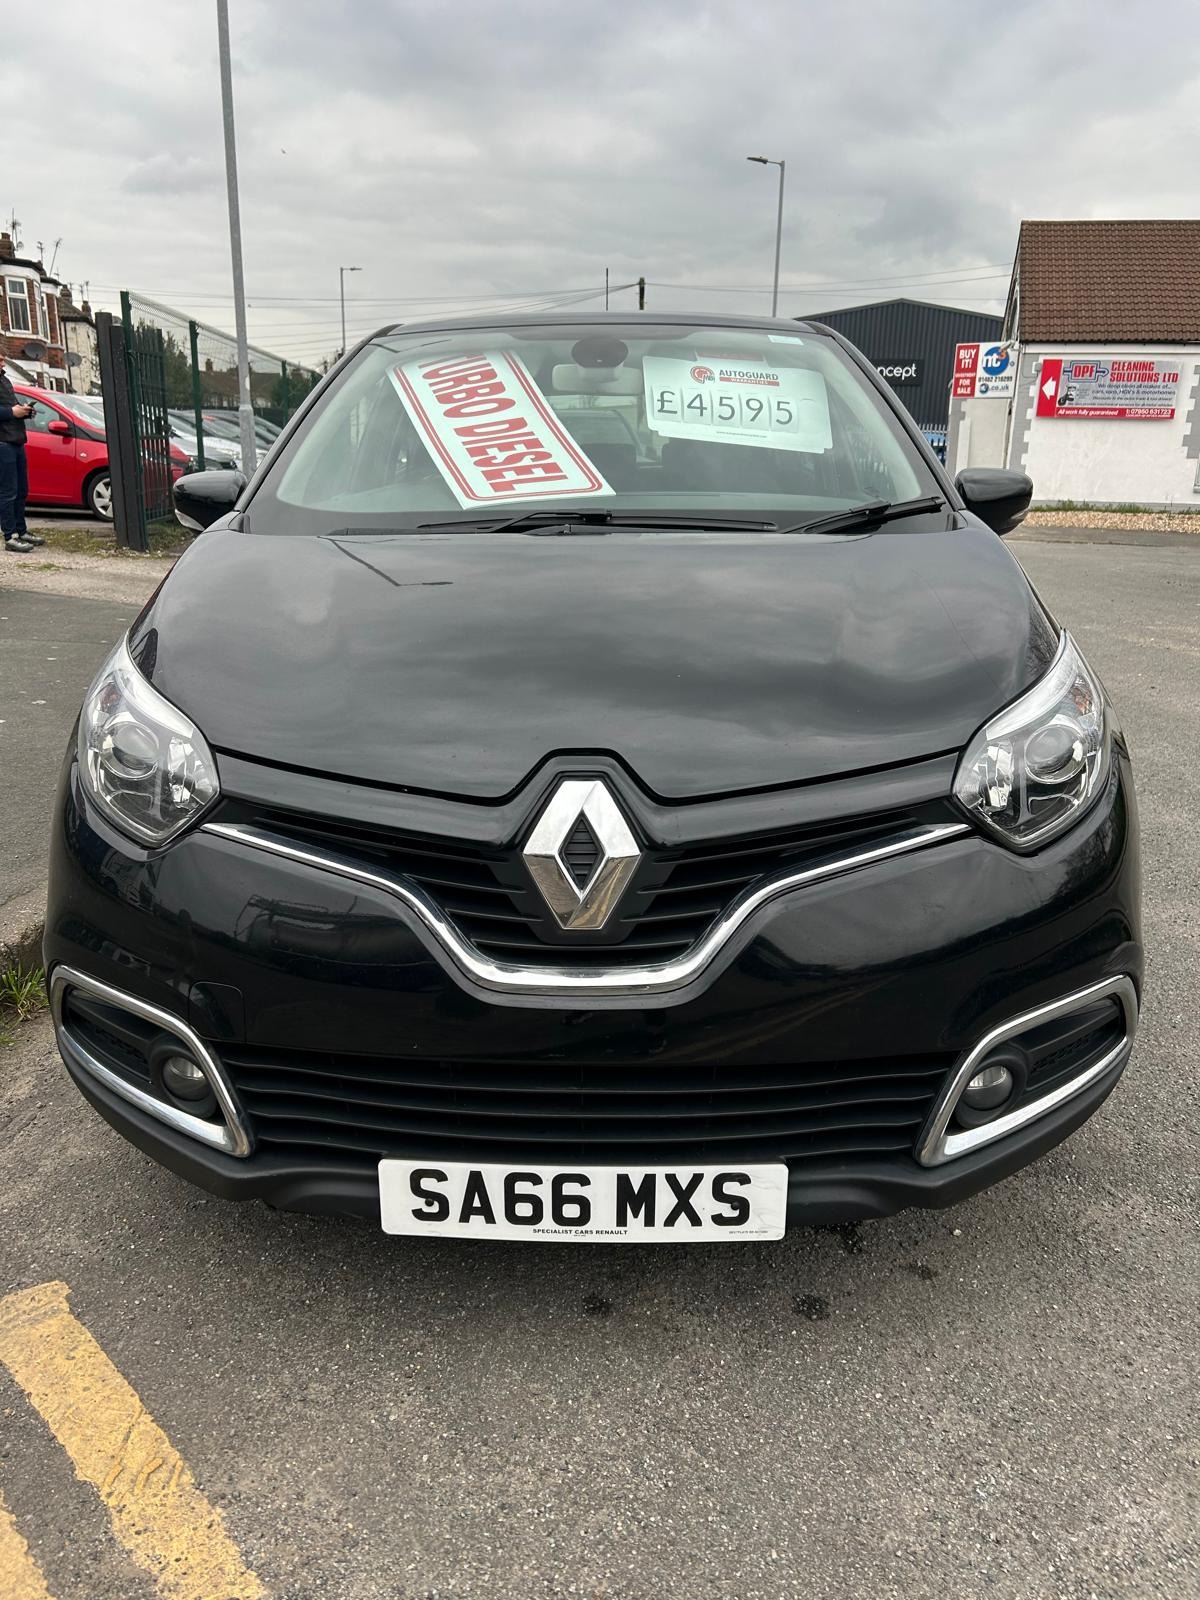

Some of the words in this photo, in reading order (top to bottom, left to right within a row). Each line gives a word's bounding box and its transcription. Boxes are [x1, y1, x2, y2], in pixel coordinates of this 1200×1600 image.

[959, 349, 976, 360] BUY
[961, 359, 973, 369] IT!
[1111, 361, 1155, 372] CLEANING
[719, 369, 779, 381] AUTOGUARD
[1073, 364, 1096, 378] DPF
[1110, 371, 1160, 383] SOLUTIONS
[1161, 372, 1179, 383] LTD
[418, 353, 516, 418] TURBO
[956, 387, 971, 395] SALE
[656, 390, 794, 426] £4595
[453, 416, 569, 493] DIESEL
[409, 1168, 592, 1227] SA66
[615, 1172, 752, 1228] MXS
